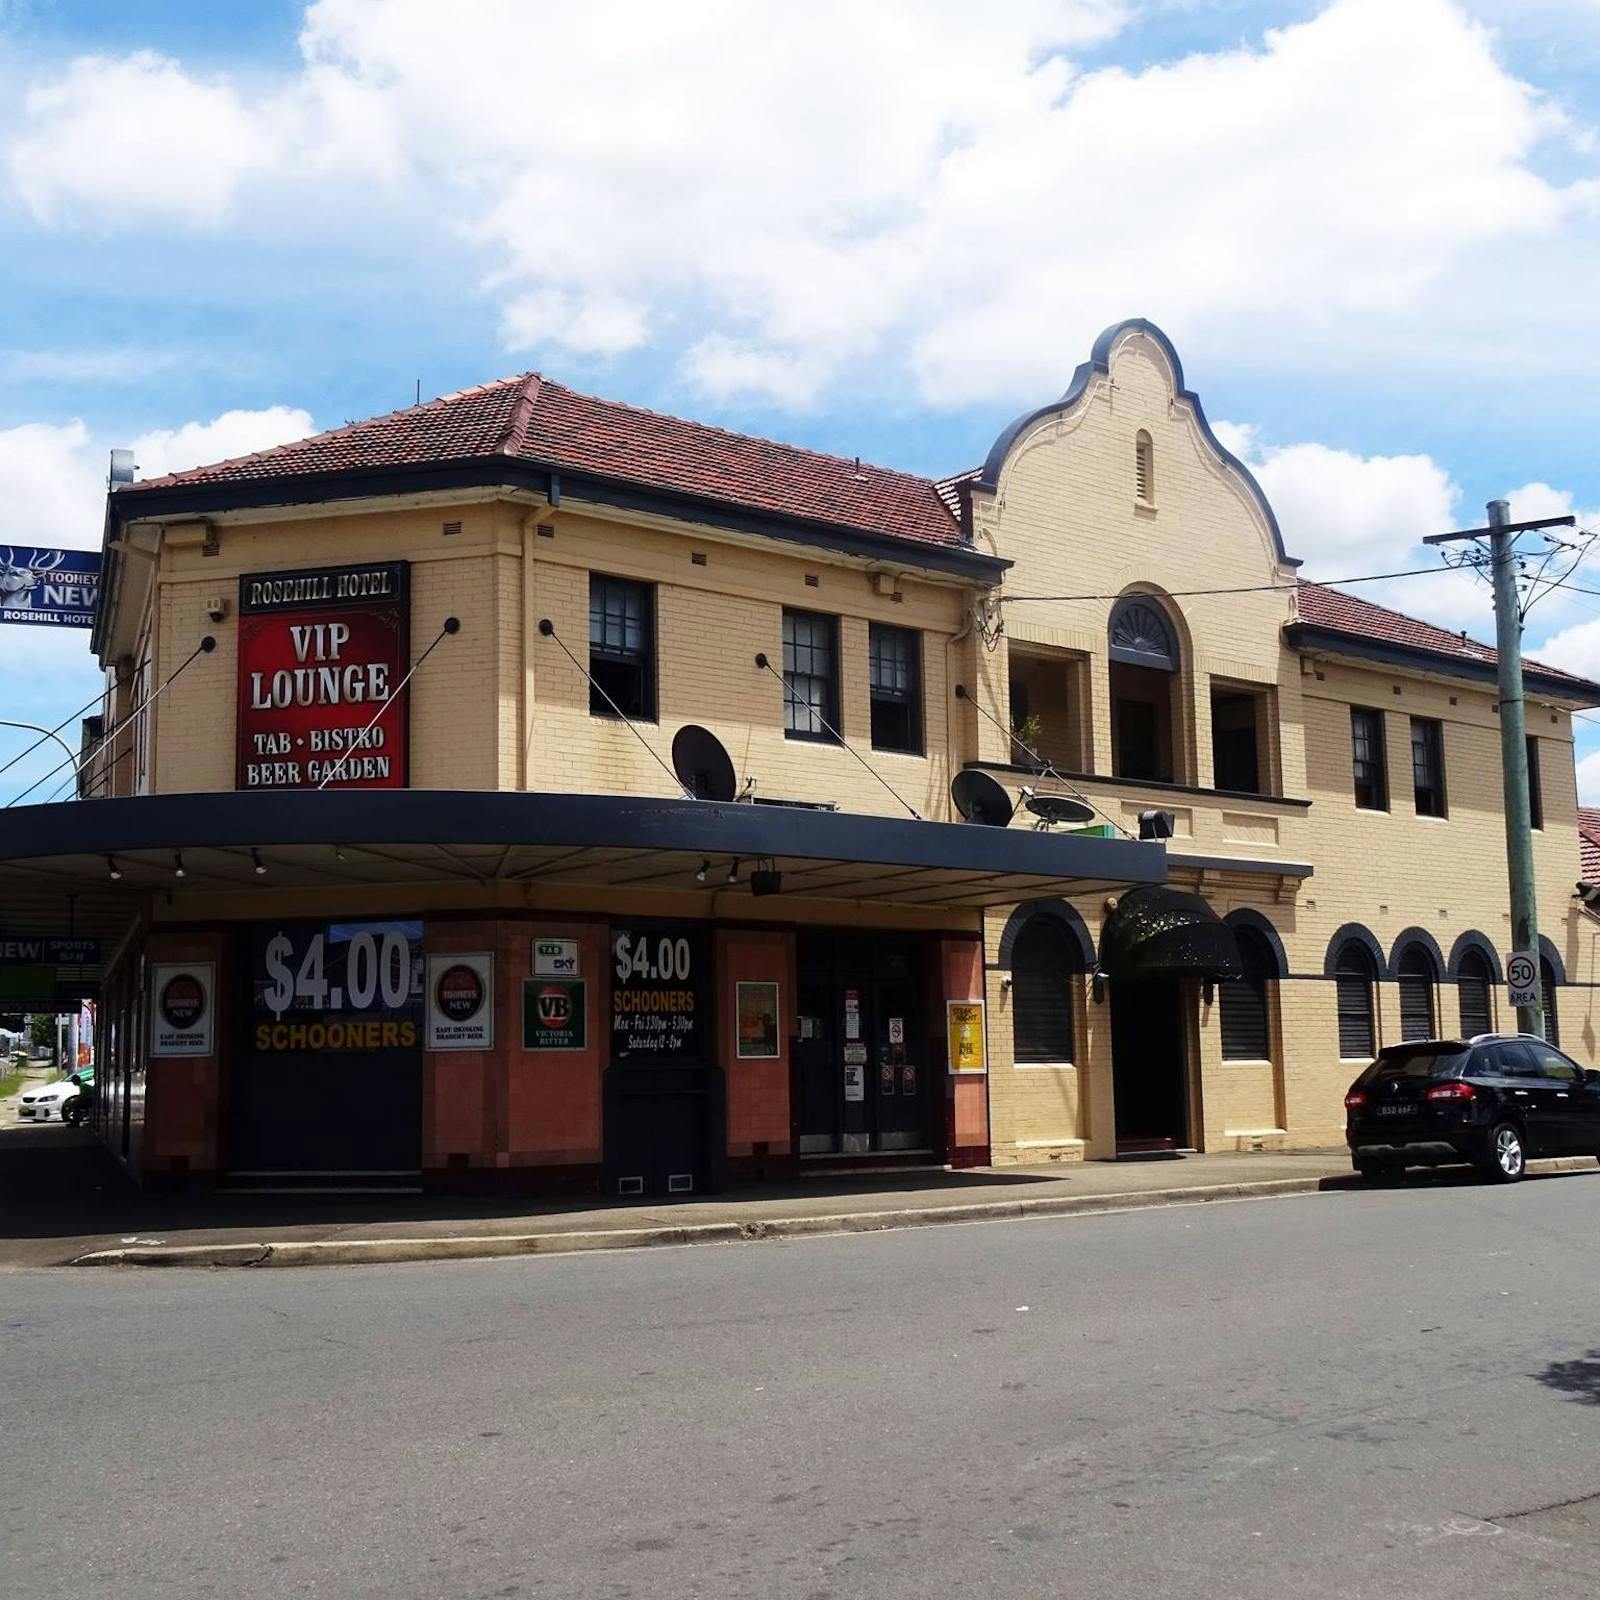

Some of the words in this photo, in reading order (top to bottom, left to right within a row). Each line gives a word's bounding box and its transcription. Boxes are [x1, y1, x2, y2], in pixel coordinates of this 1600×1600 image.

[48, 572, 99, 585] TOOHEY
[250, 576, 332, 605] ROSEHILL
[336, 571, 392, 598] HOTEL
[3, 610, 60, 622] ROSEHILL
[63, 614, 94, 625] HOTE
[290, 623, 350, 662] VIP
[251, 663, 390, 710] LOUNGE
[253, 732, 292, 755] TAB
[310, 726, 385, 752] BISTRO
[247, 762, 302, 786] BEER
[307, 756, 390, 782] GARDEN
[0, 941, 40, 959] EW
[615, 933, 691, 984] $4.00
[263, 929, 411, 1022] $4.00
[1511, 965, 1531, 981] 50
[449, 1000, 471, 1010] NEW
[538, 996, 568, 1018] VB
[613, 990, 695, 1012] SCHOONERS
[1510, 991, 1536, 1002] AREA
[173, 1008, 193, 1018] NEW
[256, 1021, 417, 1051] SCHOONERS
[536, 1030, 574, 1038] VICTORIA
[539, 1038, 569, 1046] BITTER
